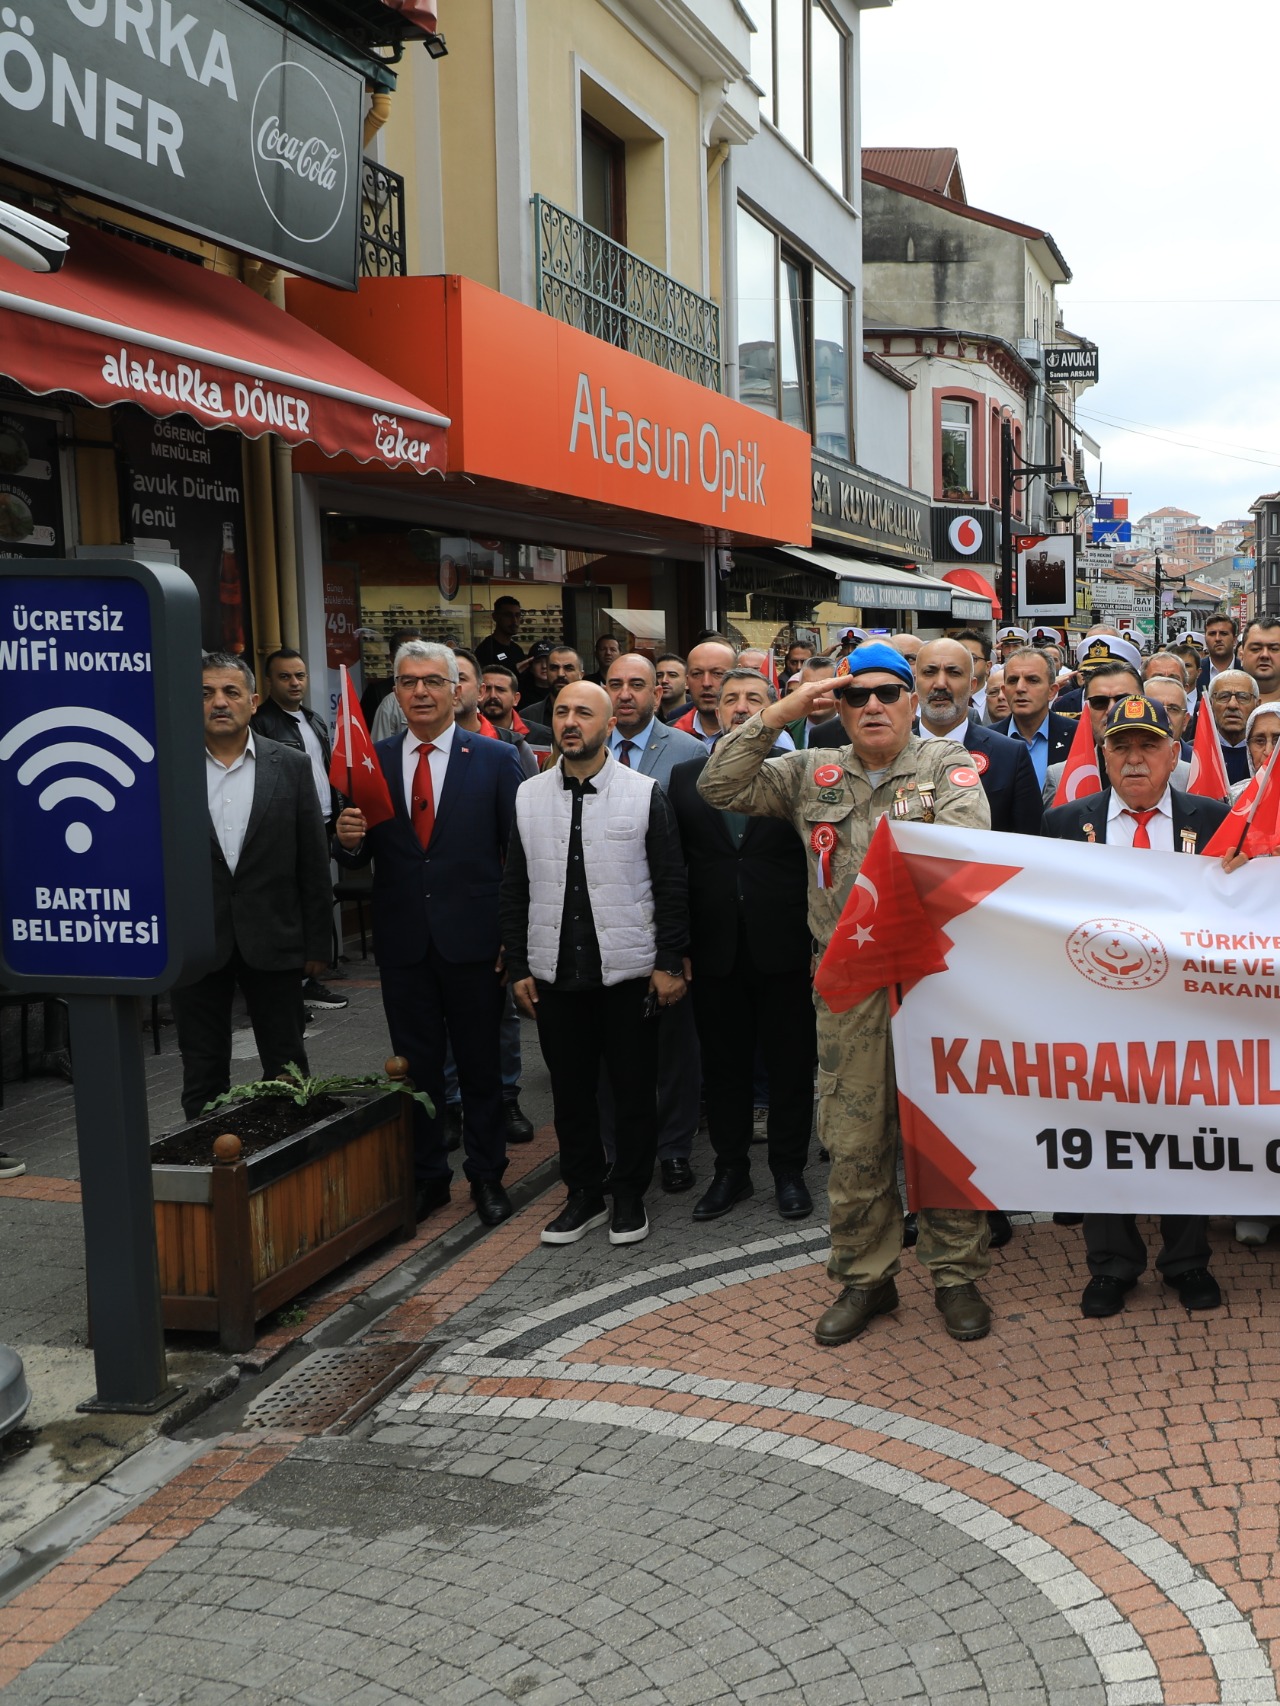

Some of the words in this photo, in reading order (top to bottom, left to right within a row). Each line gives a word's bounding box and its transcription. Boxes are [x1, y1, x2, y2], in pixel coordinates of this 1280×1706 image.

[257, 116, 341, 190] Coca-Cola
[1061, 351, 1097, 367] AVUKAT
[234, 380, 310, 434] DÖNER
[153, 419, 206, 445] ÖĞRENCİ
[569, 372, 690, 486] Atasun
[699, 422, 767, 513] Optik
[151, 442, 211, 464] MENÜLERİ
[130, 468, 178, 496] avuk
[183, 476, 240, 503] Dürüm
[839, 481, 921, 542] KUYUMCULUK
[1097, 532, 1120, 542] AXA
[12, 604, 124, 632] ÜCRETSİZ
[64, 651, 152, 672] NOKTASI
[35, 886, 131, 911] BARTIN
[12, 914, 159, 944] BELEDİYESİ
[1182, 951, 1237, 975] AİLE
[1244, 957, 1276, 976] VE
[1035, 1128, 1093, 1170] 19
[1105, 1127, 1254, 1172] EYLÜL
